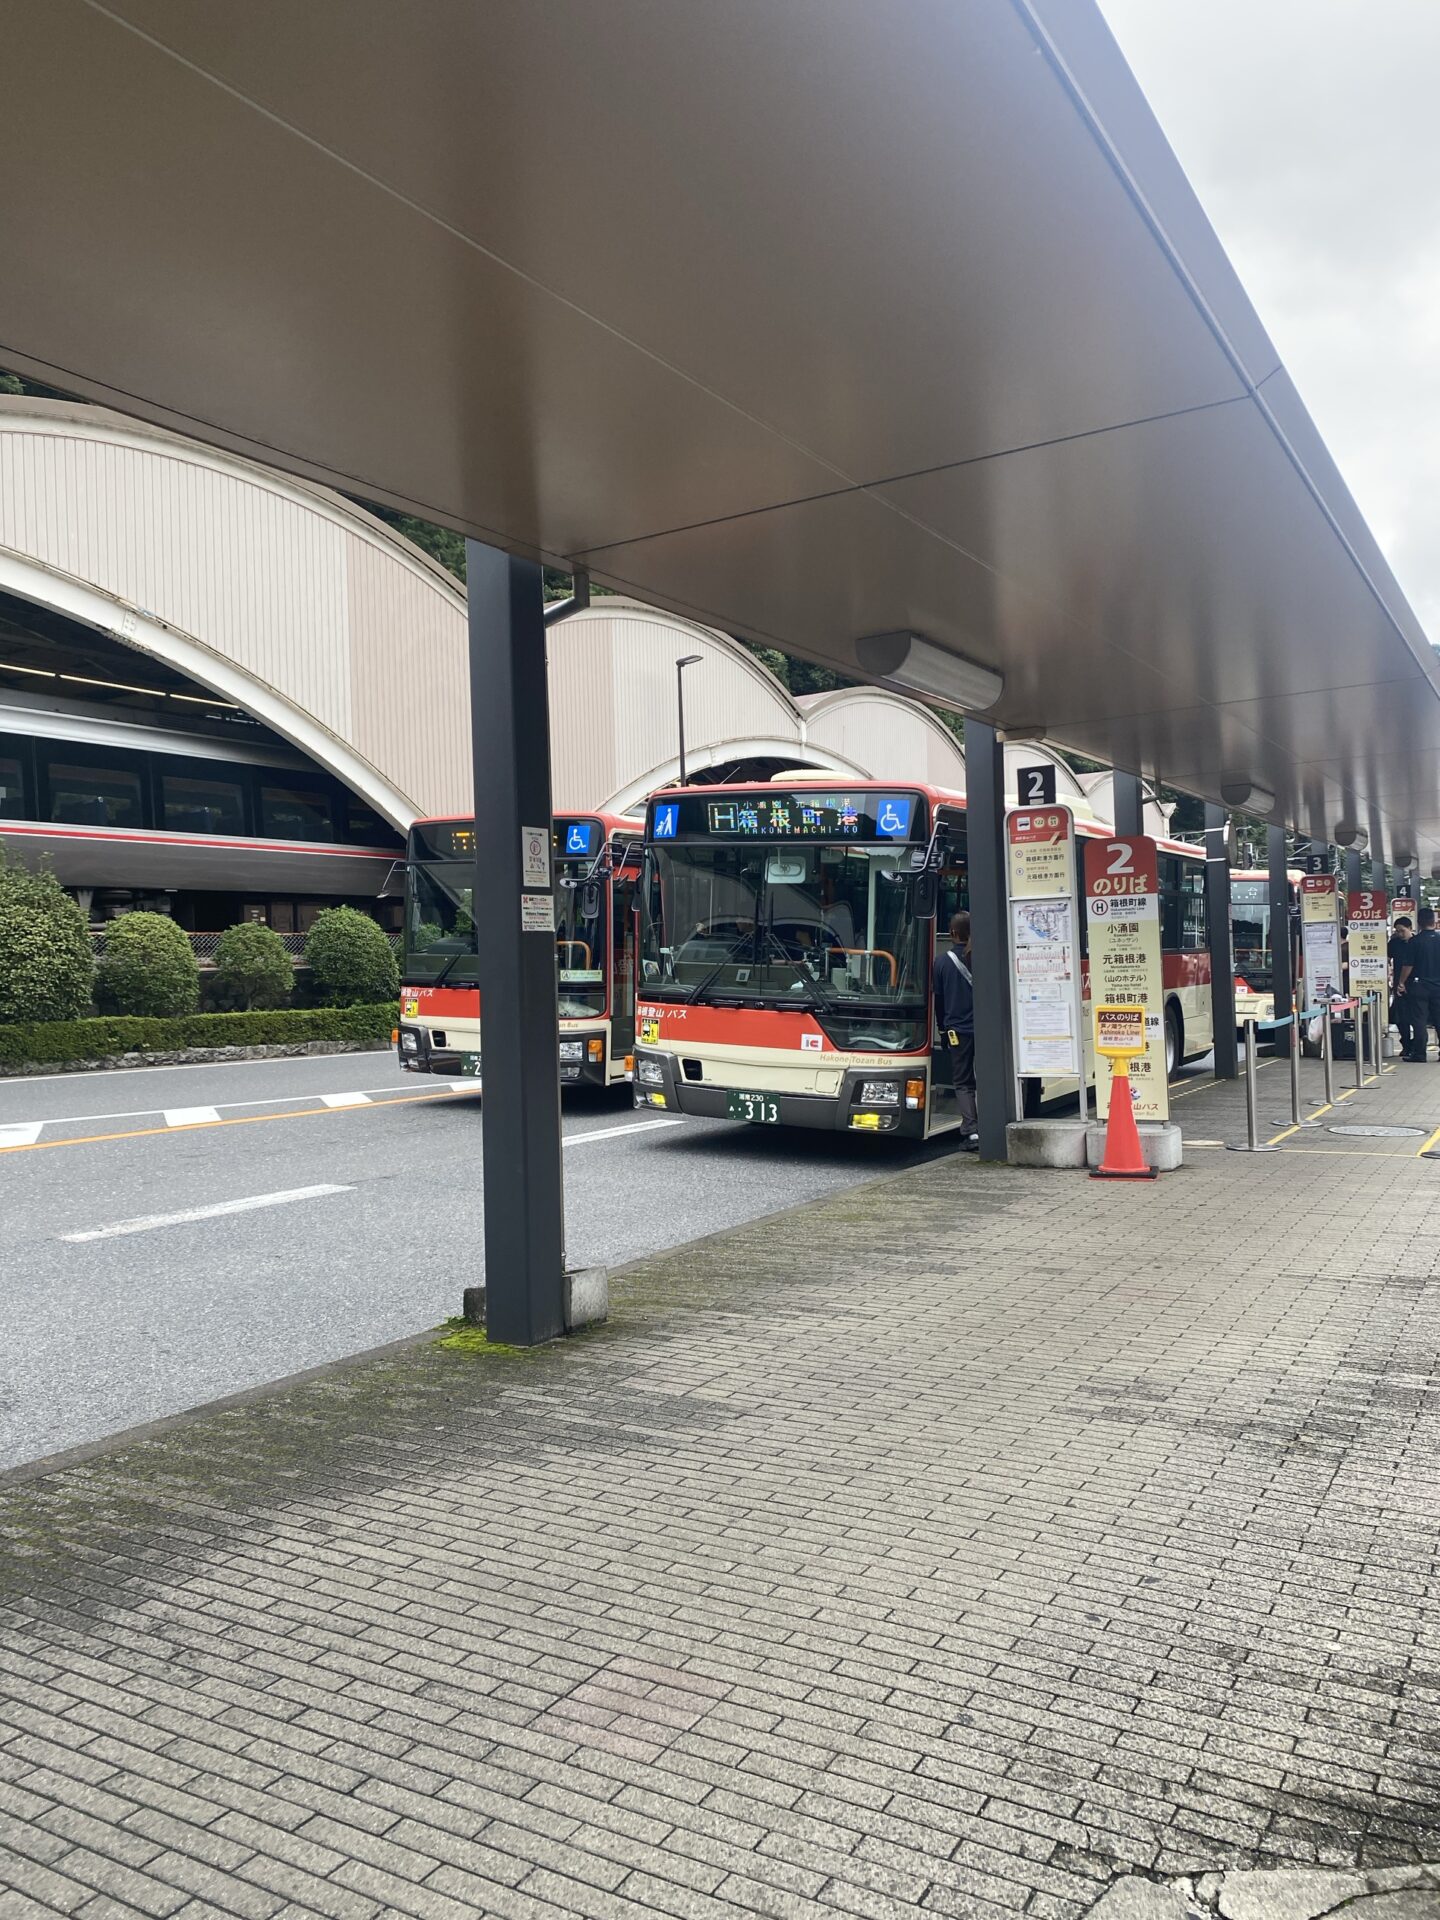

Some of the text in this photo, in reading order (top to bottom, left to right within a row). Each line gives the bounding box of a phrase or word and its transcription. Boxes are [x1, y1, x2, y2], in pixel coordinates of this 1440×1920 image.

[1028, 771, 1045, 798] 2
[714, 807, 735, 829] H
[739, 806, 858, 828] 箱根町港
[744, 826, 858, 835] HAKONEMACHI-KO
[1106, 843, 1135, 875] 2
[1312, 856, 1322, 871] 3
[1093, 873, 1148, 895] のりば
[1400, 886, 1407, 896] 4
[1110, 898, 1147, 908] 箱根町線
[1360, 892, 1374, 910] 3
[1096, 903, 1104, 912] H
[1352, 910, 1382, 919] のりば
[1107, 922, 1139, 934] 小涌園
[1103, 953, 1147, 965] 元箱根港
[1104, 992, 1149, 1004] 箱根町港
[1100, 1013, 1139, 1022] バスのりば
[820, 1054, 893, 1066] Hakone Tozan Bus
